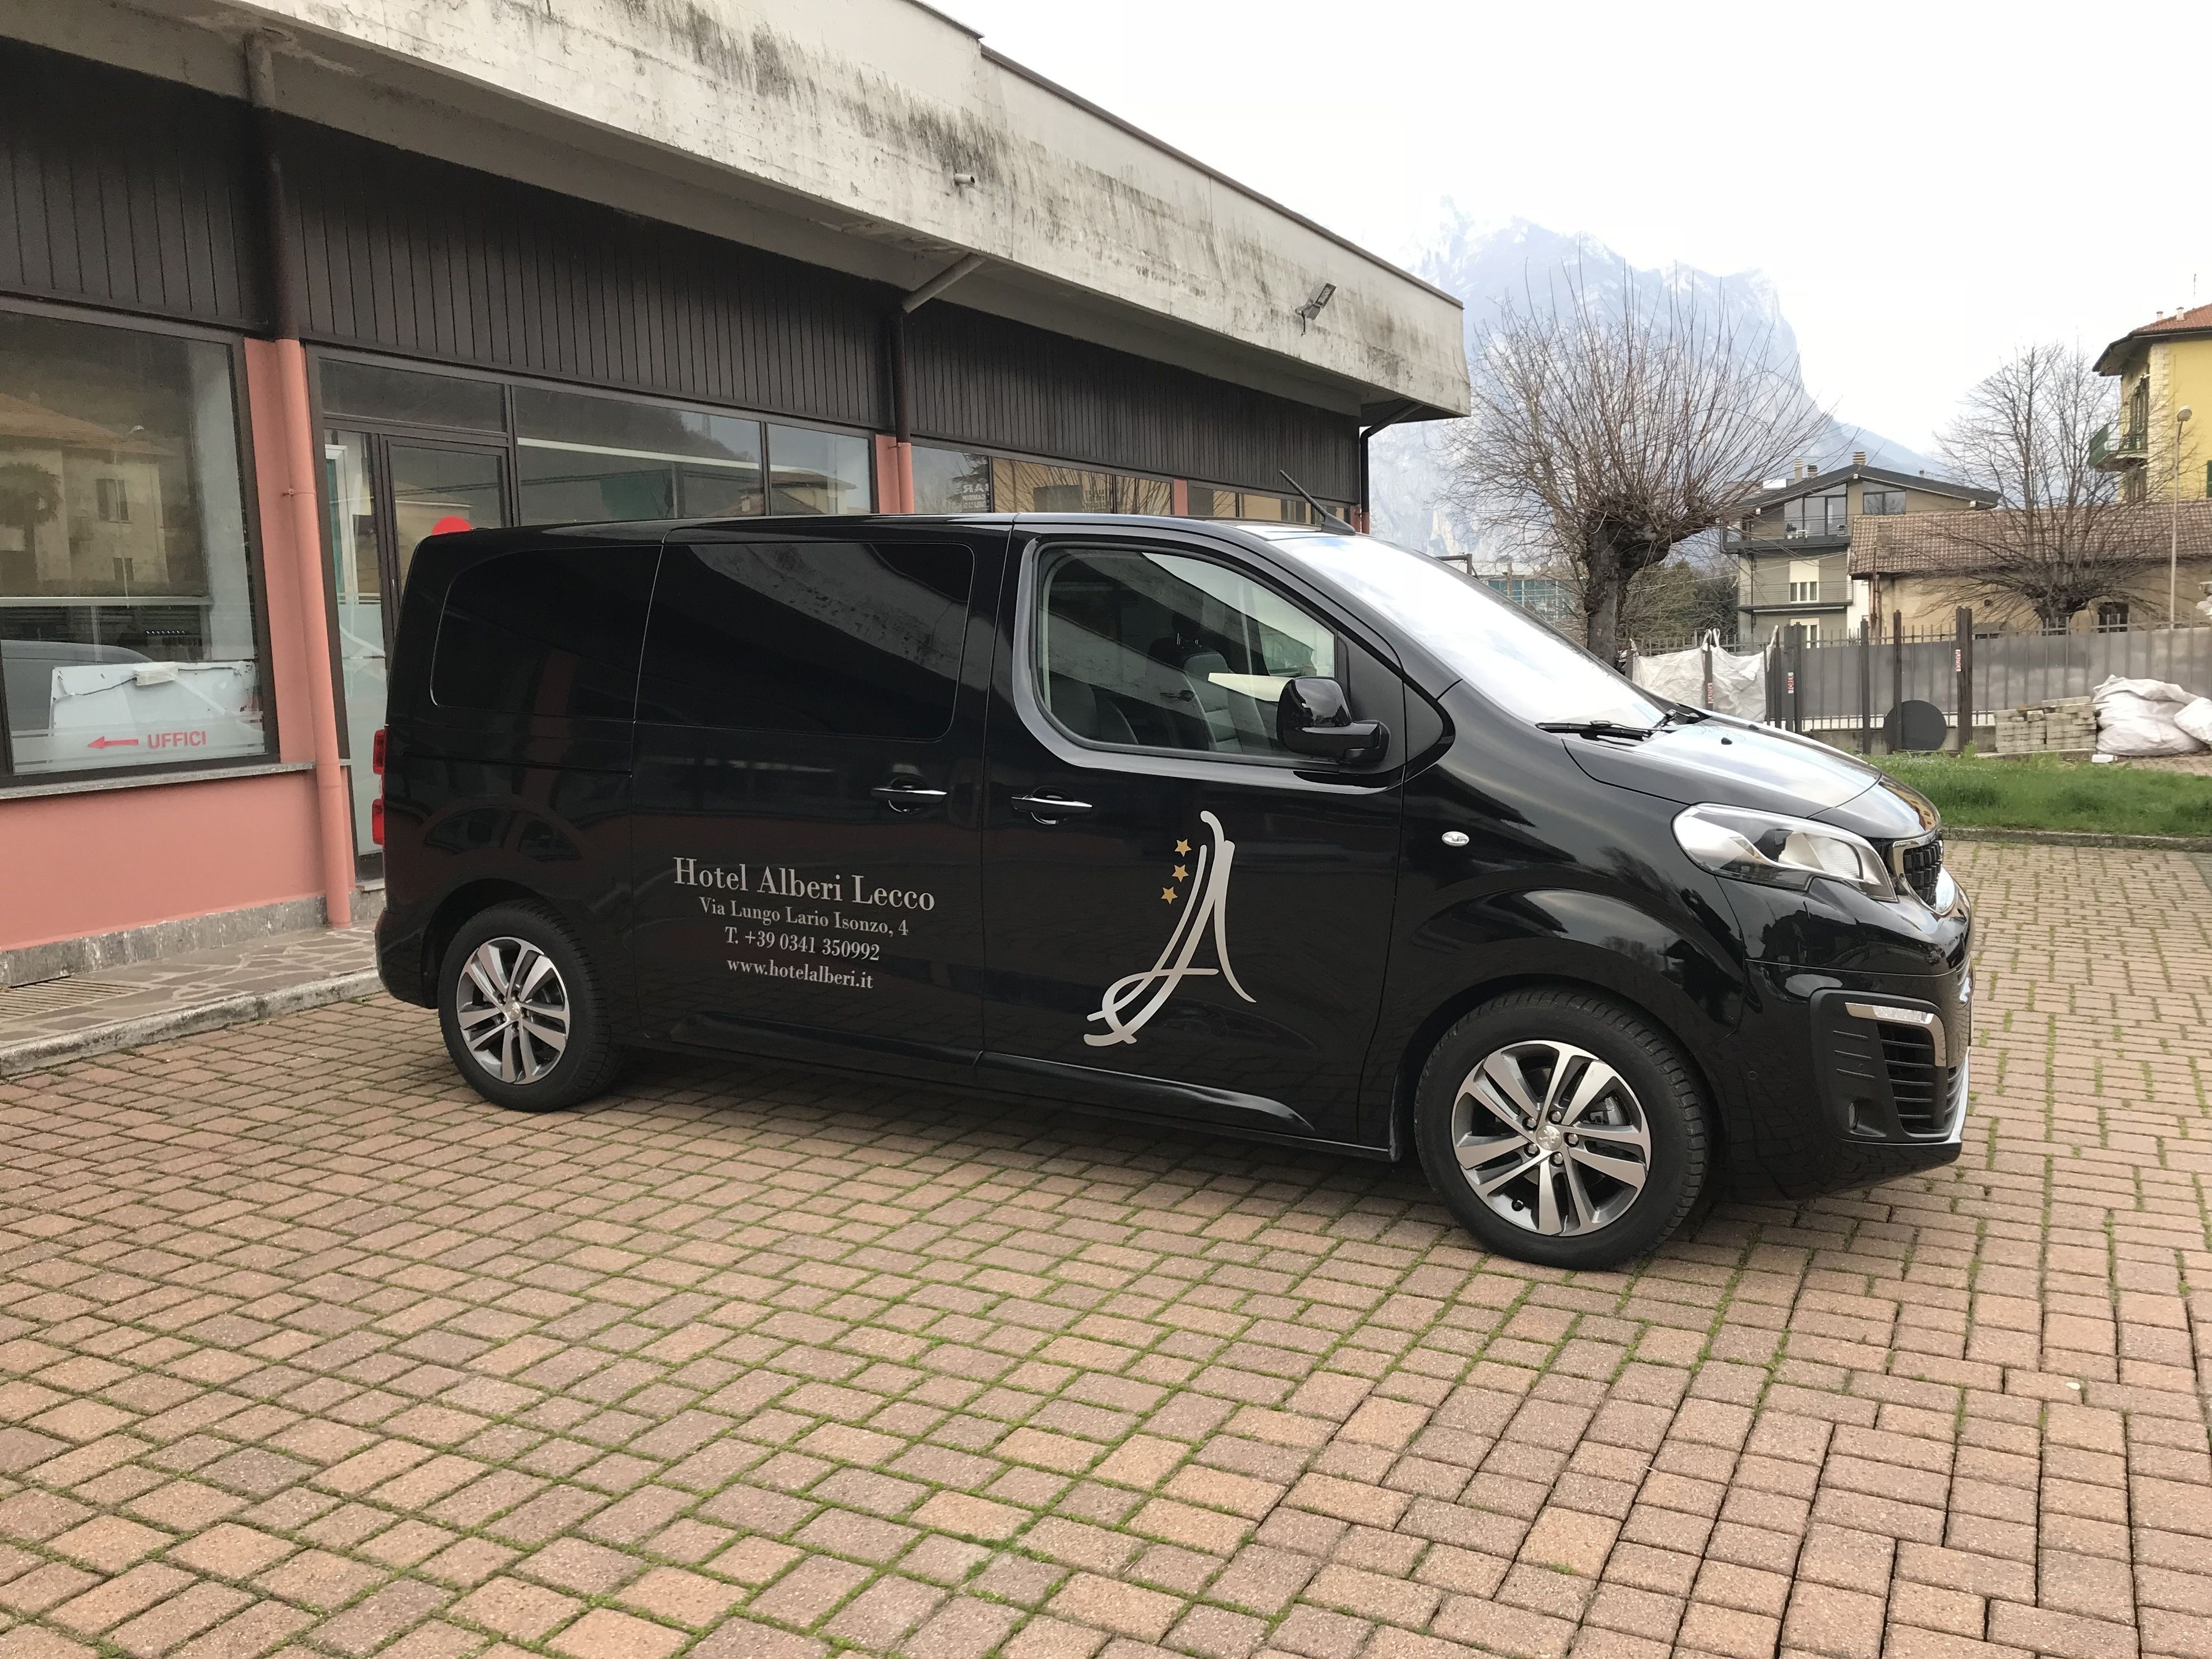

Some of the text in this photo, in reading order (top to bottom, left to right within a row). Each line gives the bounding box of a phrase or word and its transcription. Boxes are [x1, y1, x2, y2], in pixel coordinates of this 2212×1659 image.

[147, 730, 207, 749] UFFICI
[673, 857, 935, 911] Hotel Alberi Lecco
[699, 896, 908, 937] Via Lungo Lario Isonzo, 4
[725, 926, 880, 961] T. +39 0341 350992
[727, 959, 873, 989] www.hotelalberi.it
